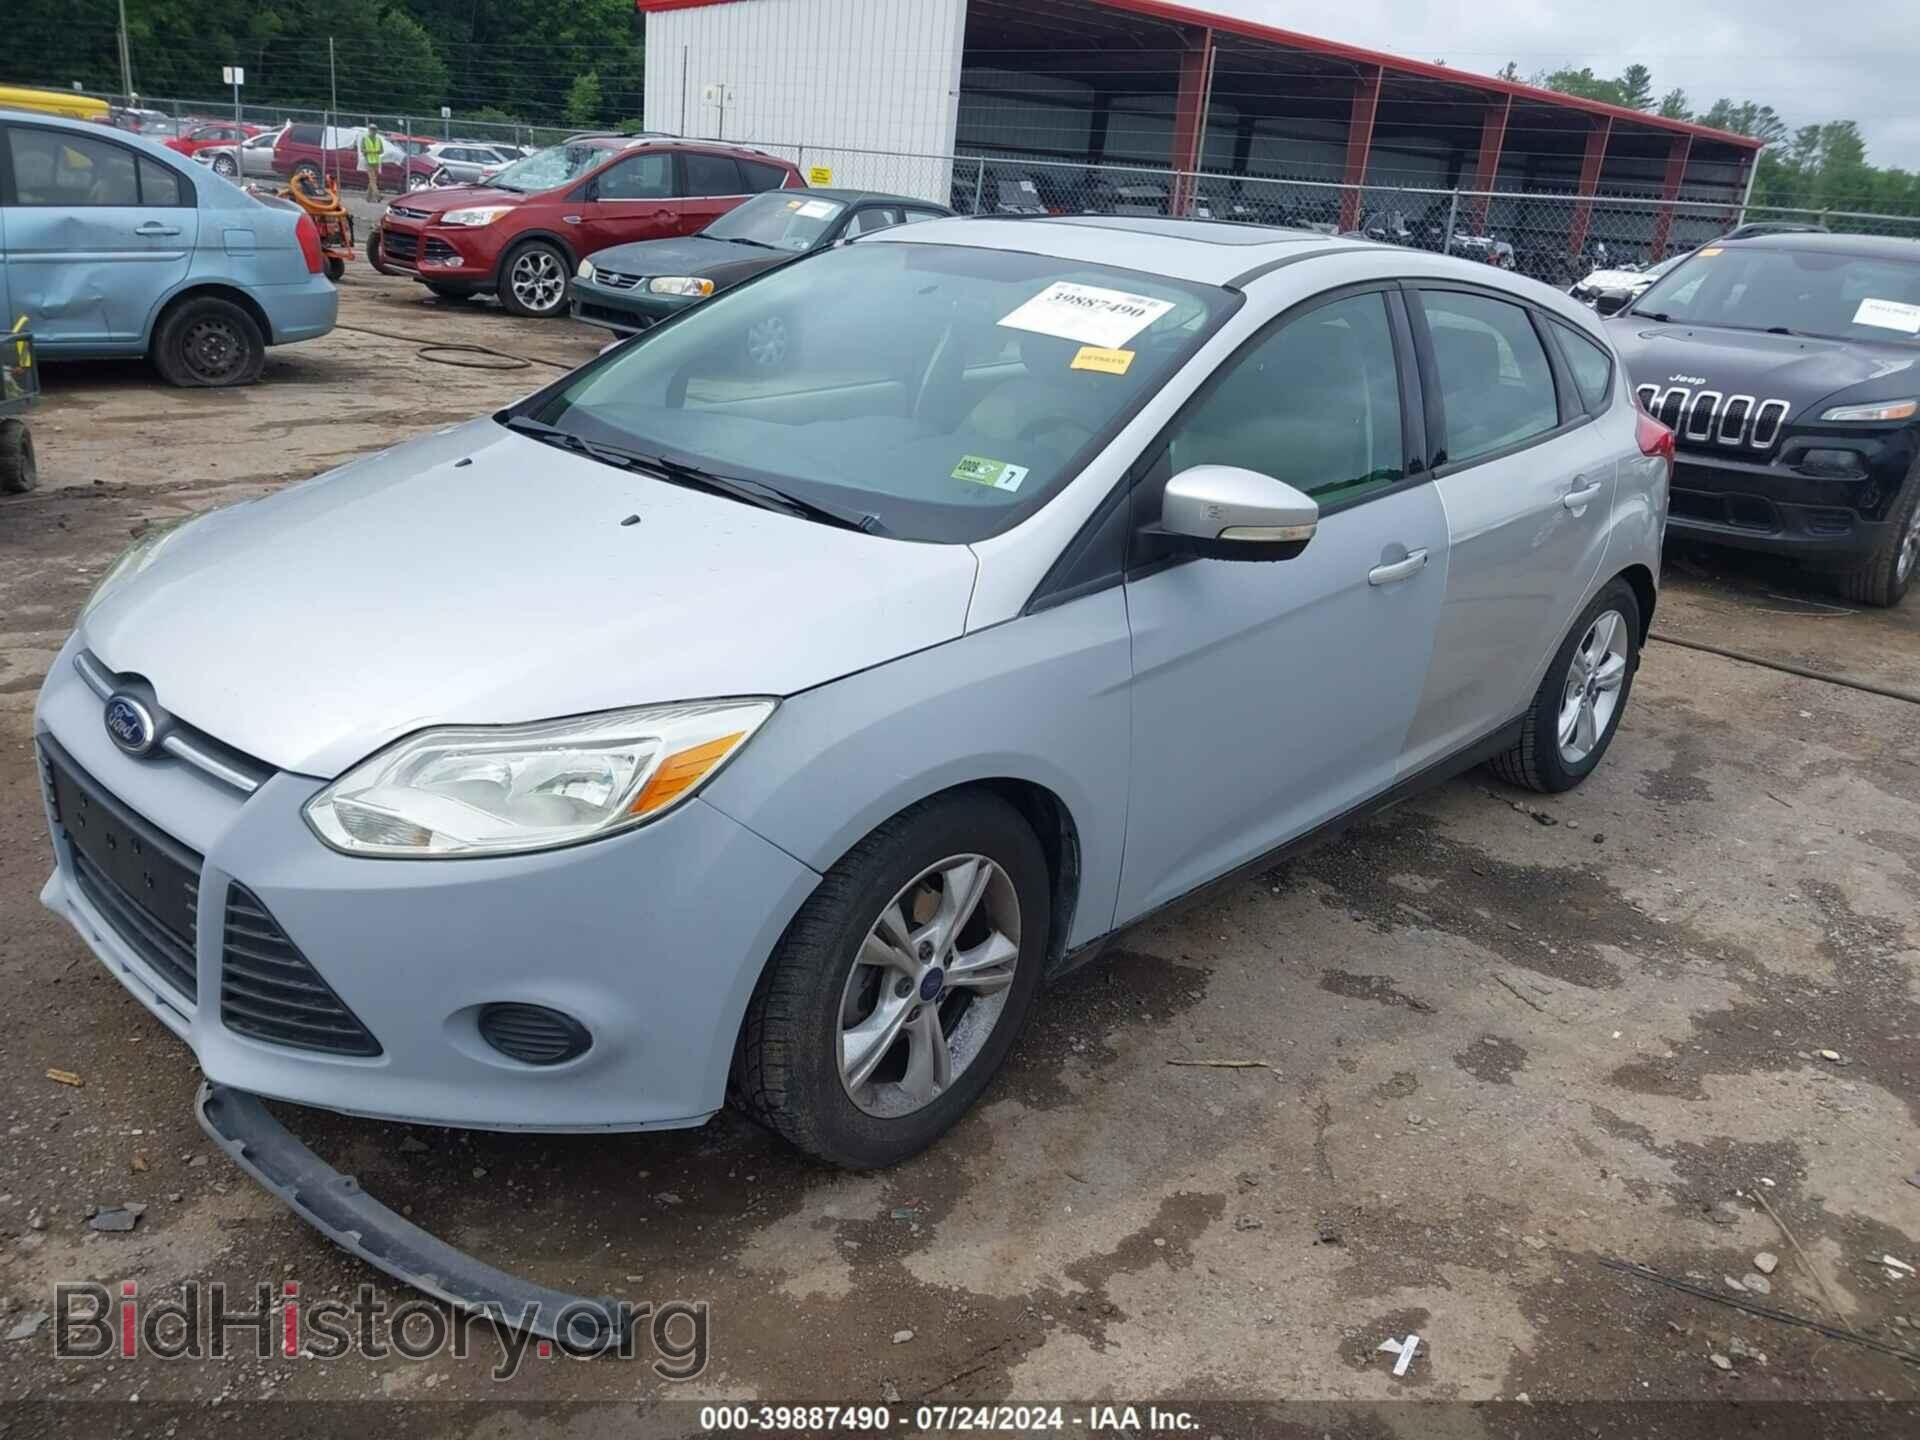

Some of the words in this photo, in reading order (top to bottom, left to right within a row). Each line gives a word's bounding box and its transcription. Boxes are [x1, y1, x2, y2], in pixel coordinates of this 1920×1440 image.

[1048, 292, 1147, 318] 39887490
[1668, 374, 1707, 385] Jeep
[109, 703, 138, 740] Ford
